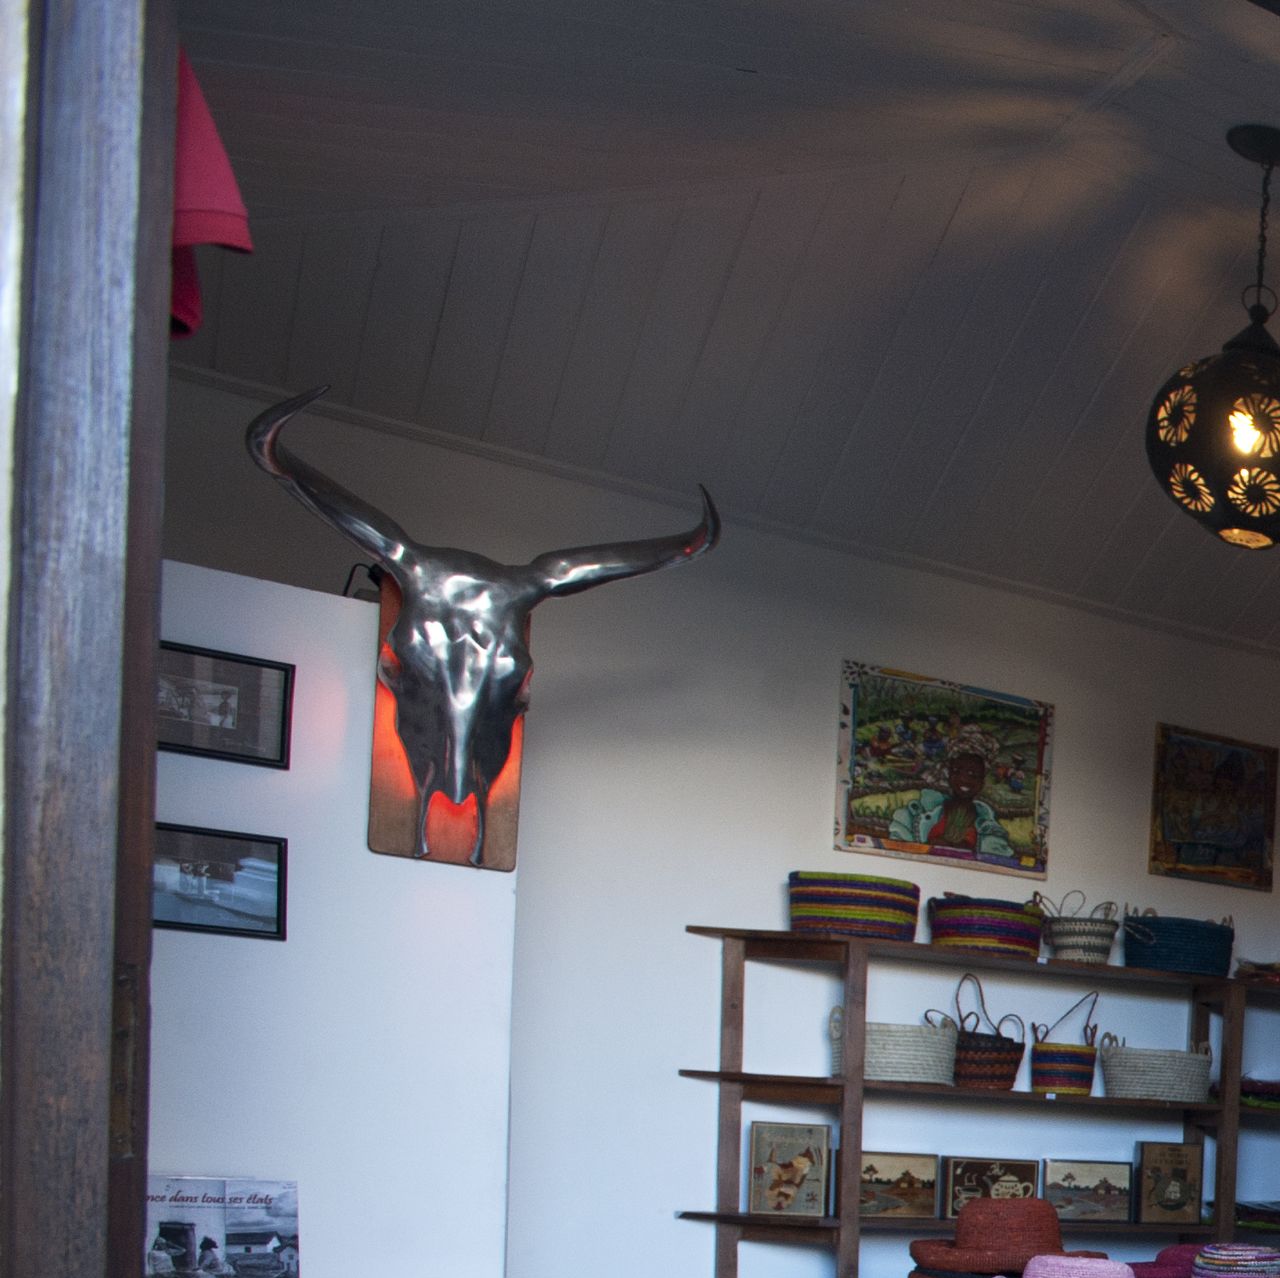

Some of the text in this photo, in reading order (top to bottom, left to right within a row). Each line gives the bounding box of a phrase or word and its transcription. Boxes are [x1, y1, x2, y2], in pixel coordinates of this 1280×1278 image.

[169, 1190, 199, 1203] dans
[201, 1192, 225, 1204] tous
[227, 1195, 243, 1204] ses
